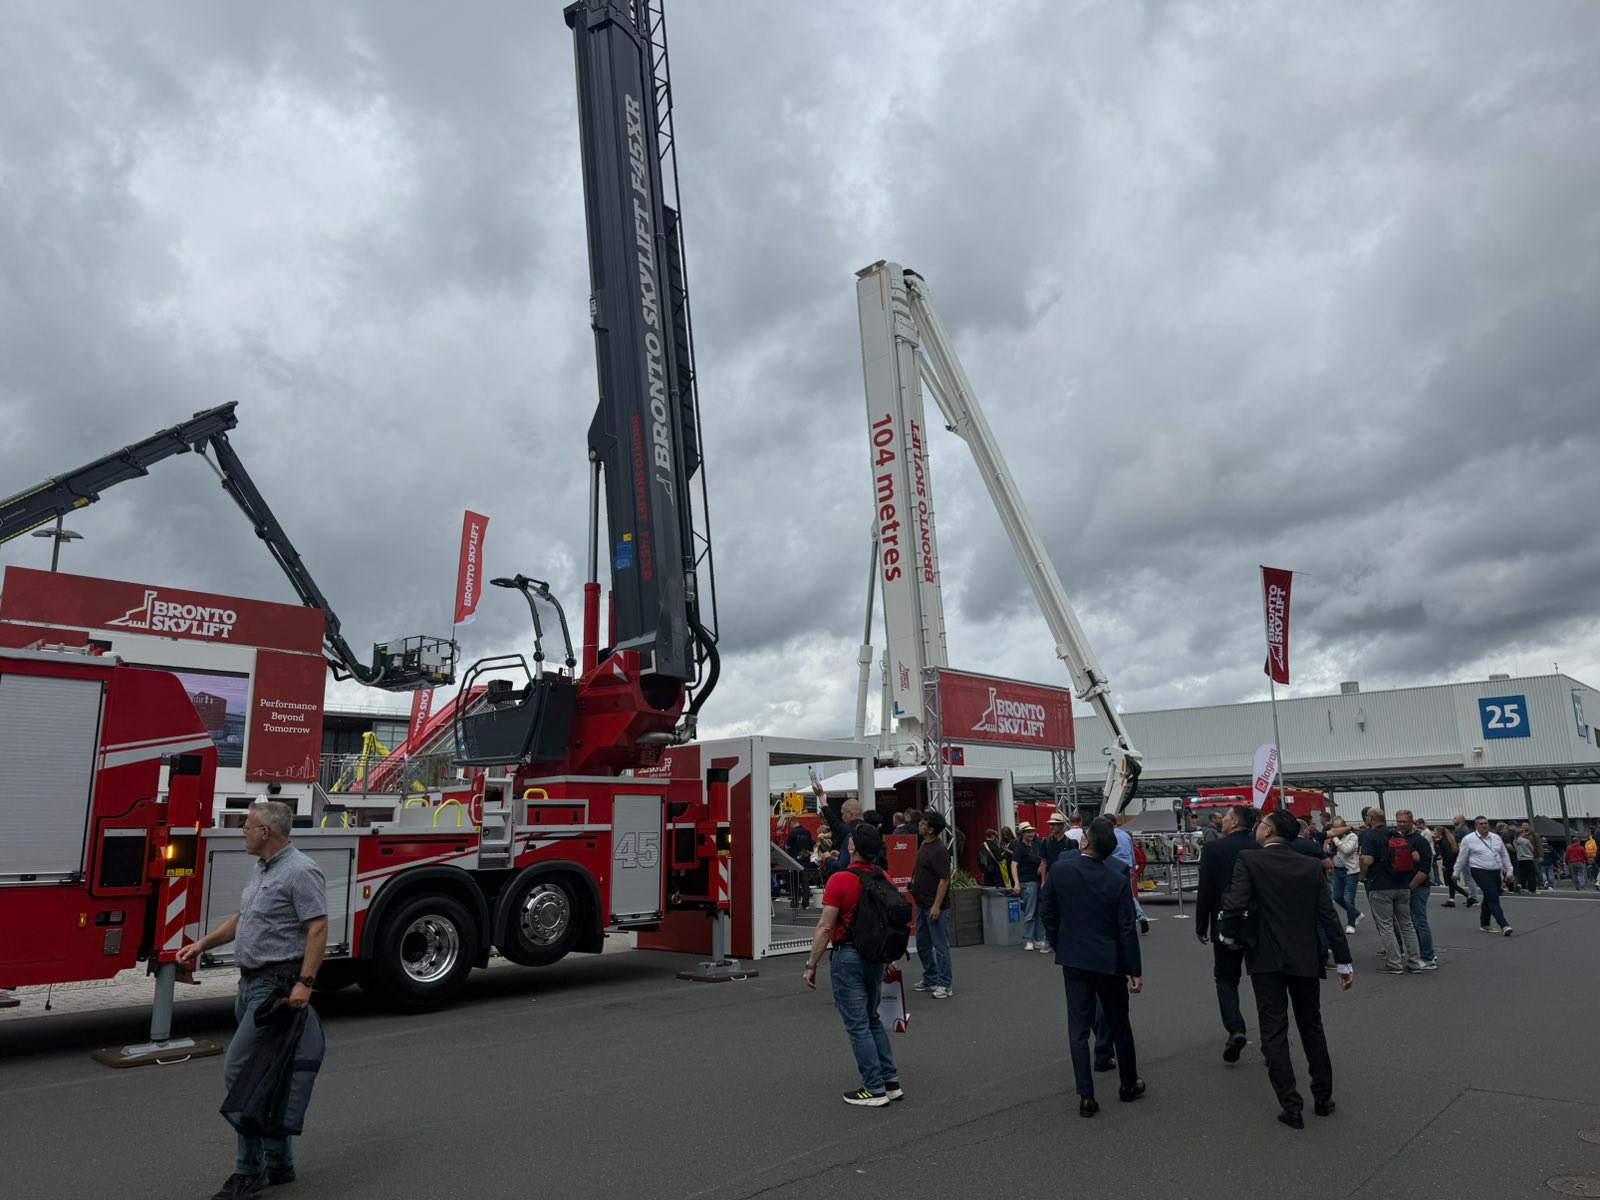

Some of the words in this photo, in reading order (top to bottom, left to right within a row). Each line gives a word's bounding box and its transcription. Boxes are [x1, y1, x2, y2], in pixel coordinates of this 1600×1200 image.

[625, 93, 647, 200] F45XR
[633, 200, 659, 330] SKYLIFT
[645, 332, 671, 473] BRONTO
[872, 413, 896, 468] 104
[911, 420, 927, 500] SKYLIFT
[468, 522, 480, 563] SKYLIFT
[877, 472, 902, 582] metres
[917, 500, 935, 584] BRONTO
[464, 564, 475, 607] BRONTO
[152, 616, 233, 638] SKYLIFT
[153, 601, 237, 624] BRONTO
[1275, 587, 1286, 643] SKYLIFT
[259, 699, 318, 711] Performance
[271, 712, 304, 723] Beyond
[996, 699, 1046, 720] BRONTO
[1485, 703, 1521, 729] 25
[263, 723, 311, 734] Tomorrow
[997, 716, 1045, 737] SKYLIFT
[1261, 747, 1278, 781] logiroll
[614, 831, 659, 869] 45
